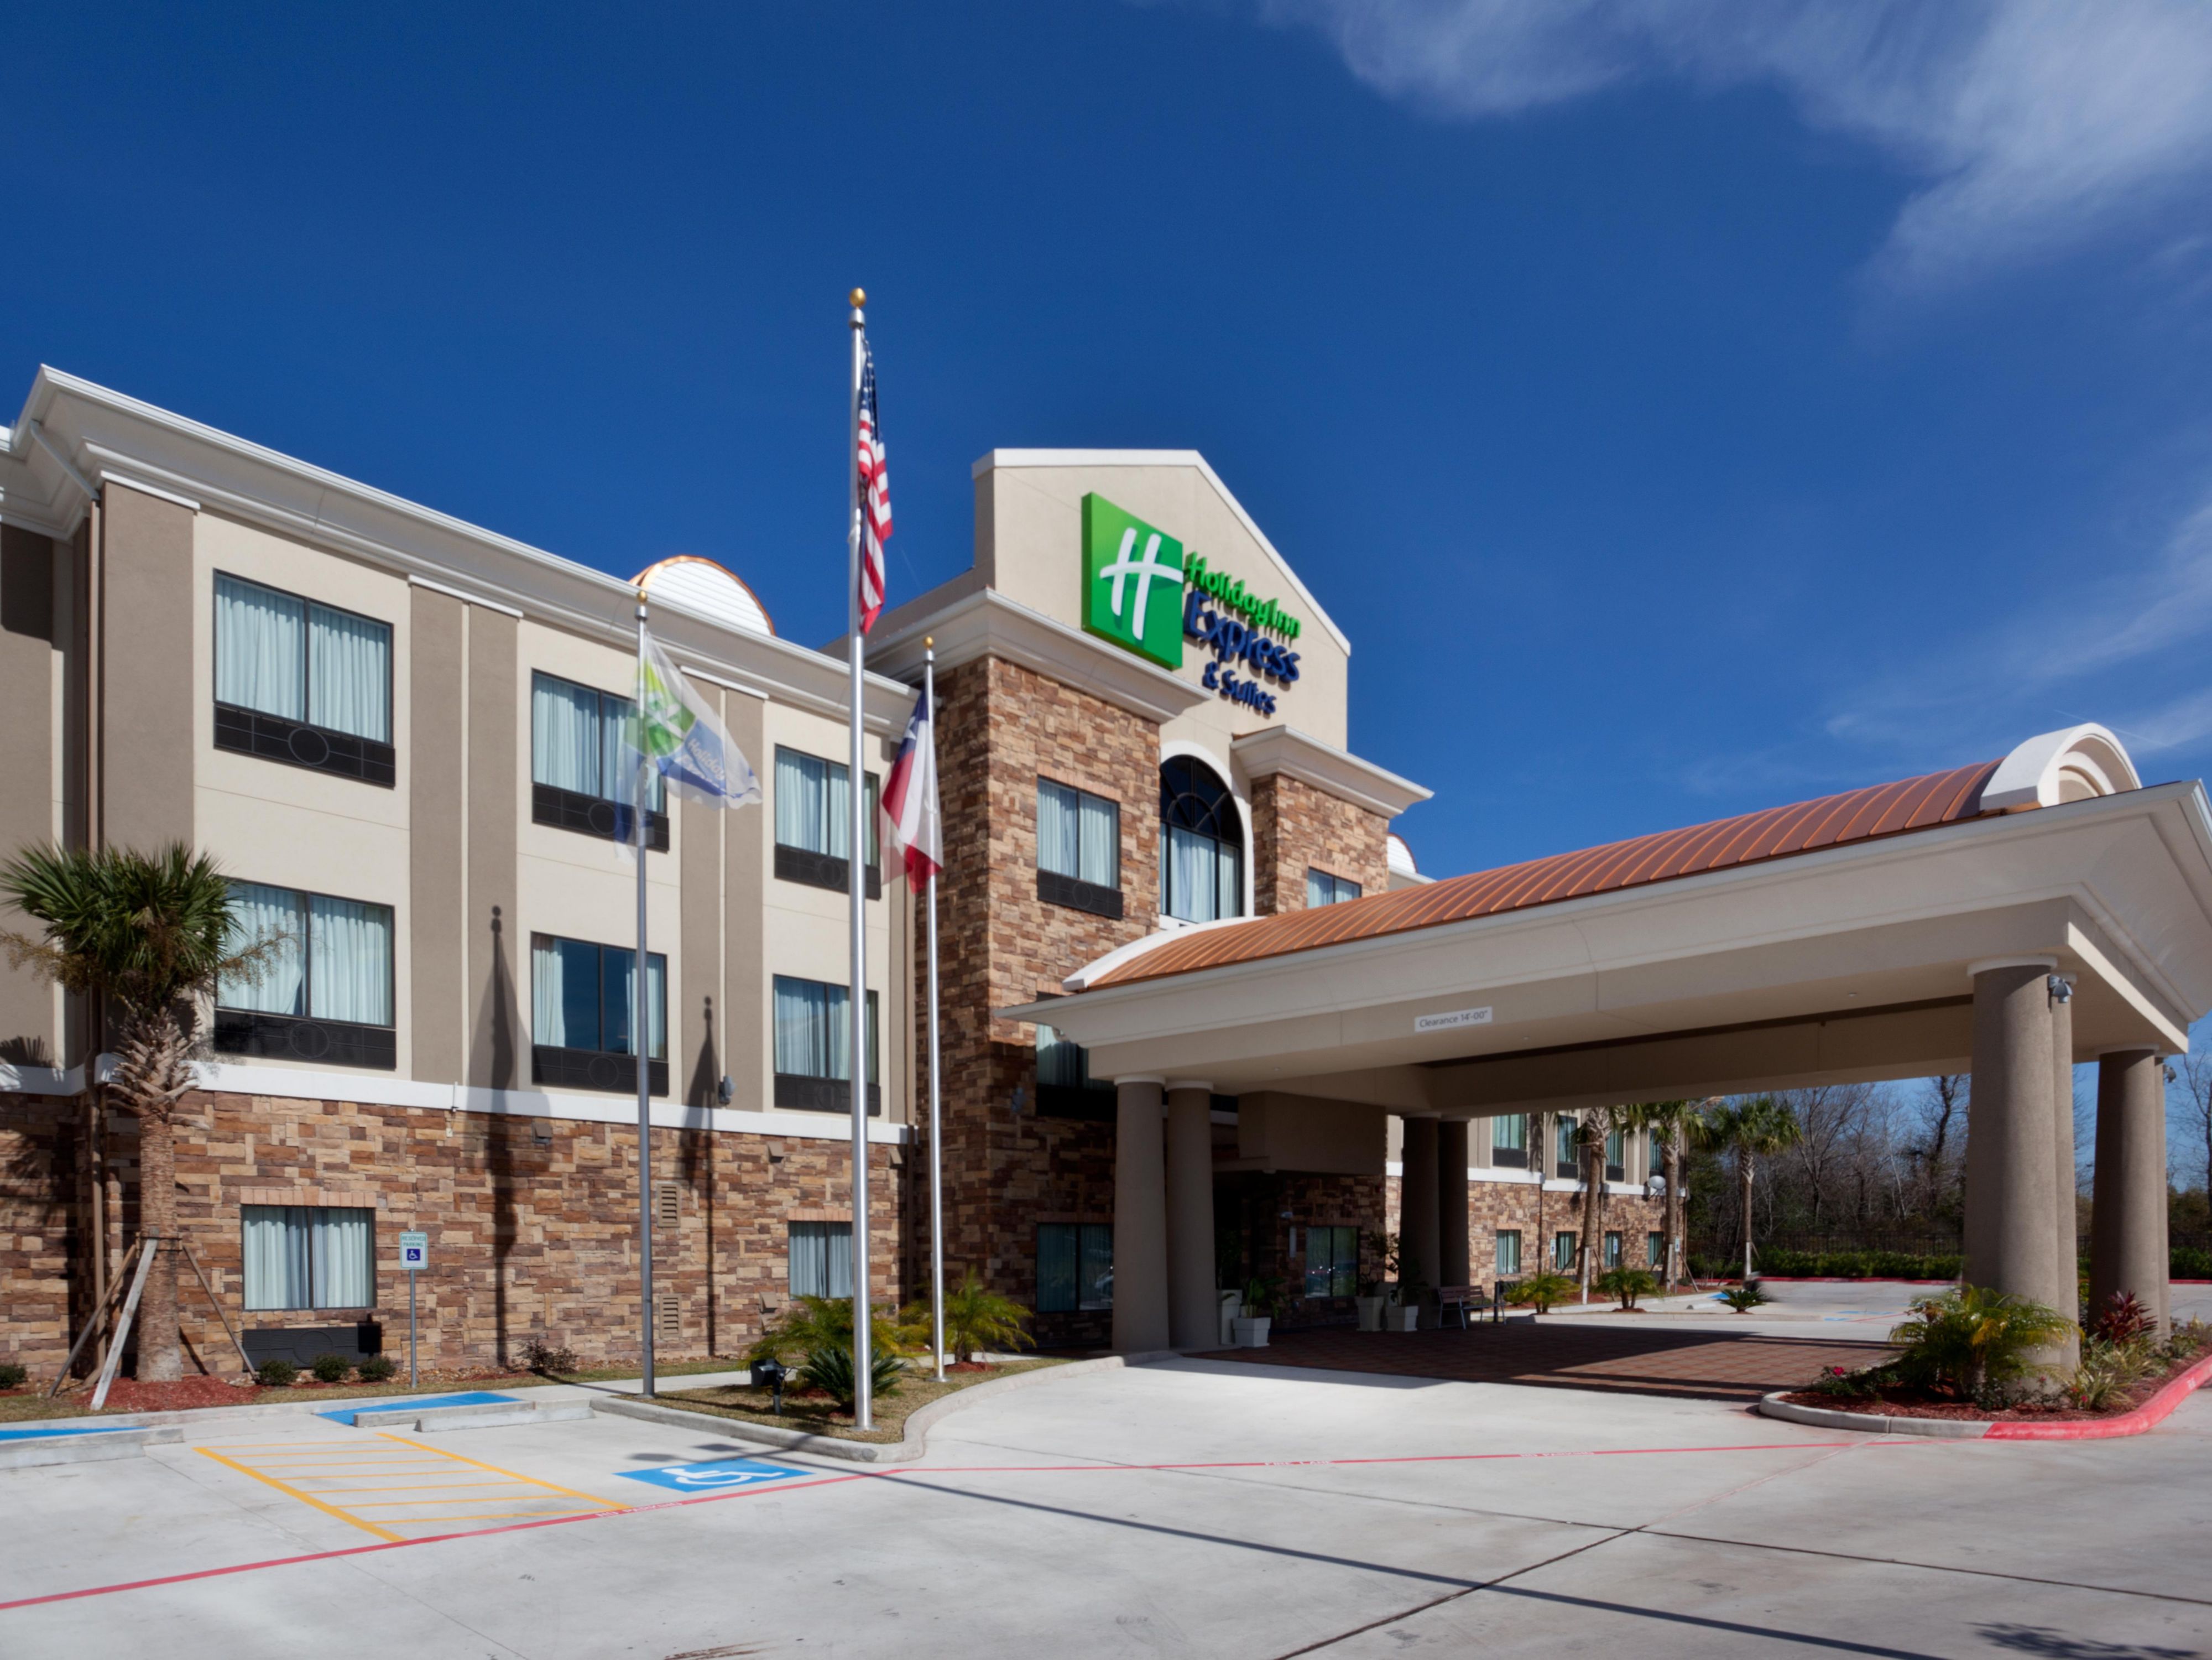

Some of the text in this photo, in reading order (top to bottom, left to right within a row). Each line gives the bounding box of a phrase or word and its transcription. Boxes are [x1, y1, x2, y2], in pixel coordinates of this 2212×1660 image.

[1184, 551, 1301, 639] Holiday Inn
[1183, 590, 1301, 684] Express
[1202, 661, 1276, 714] & Suites
[1420, 1016, 1458, 1028] Clearance
